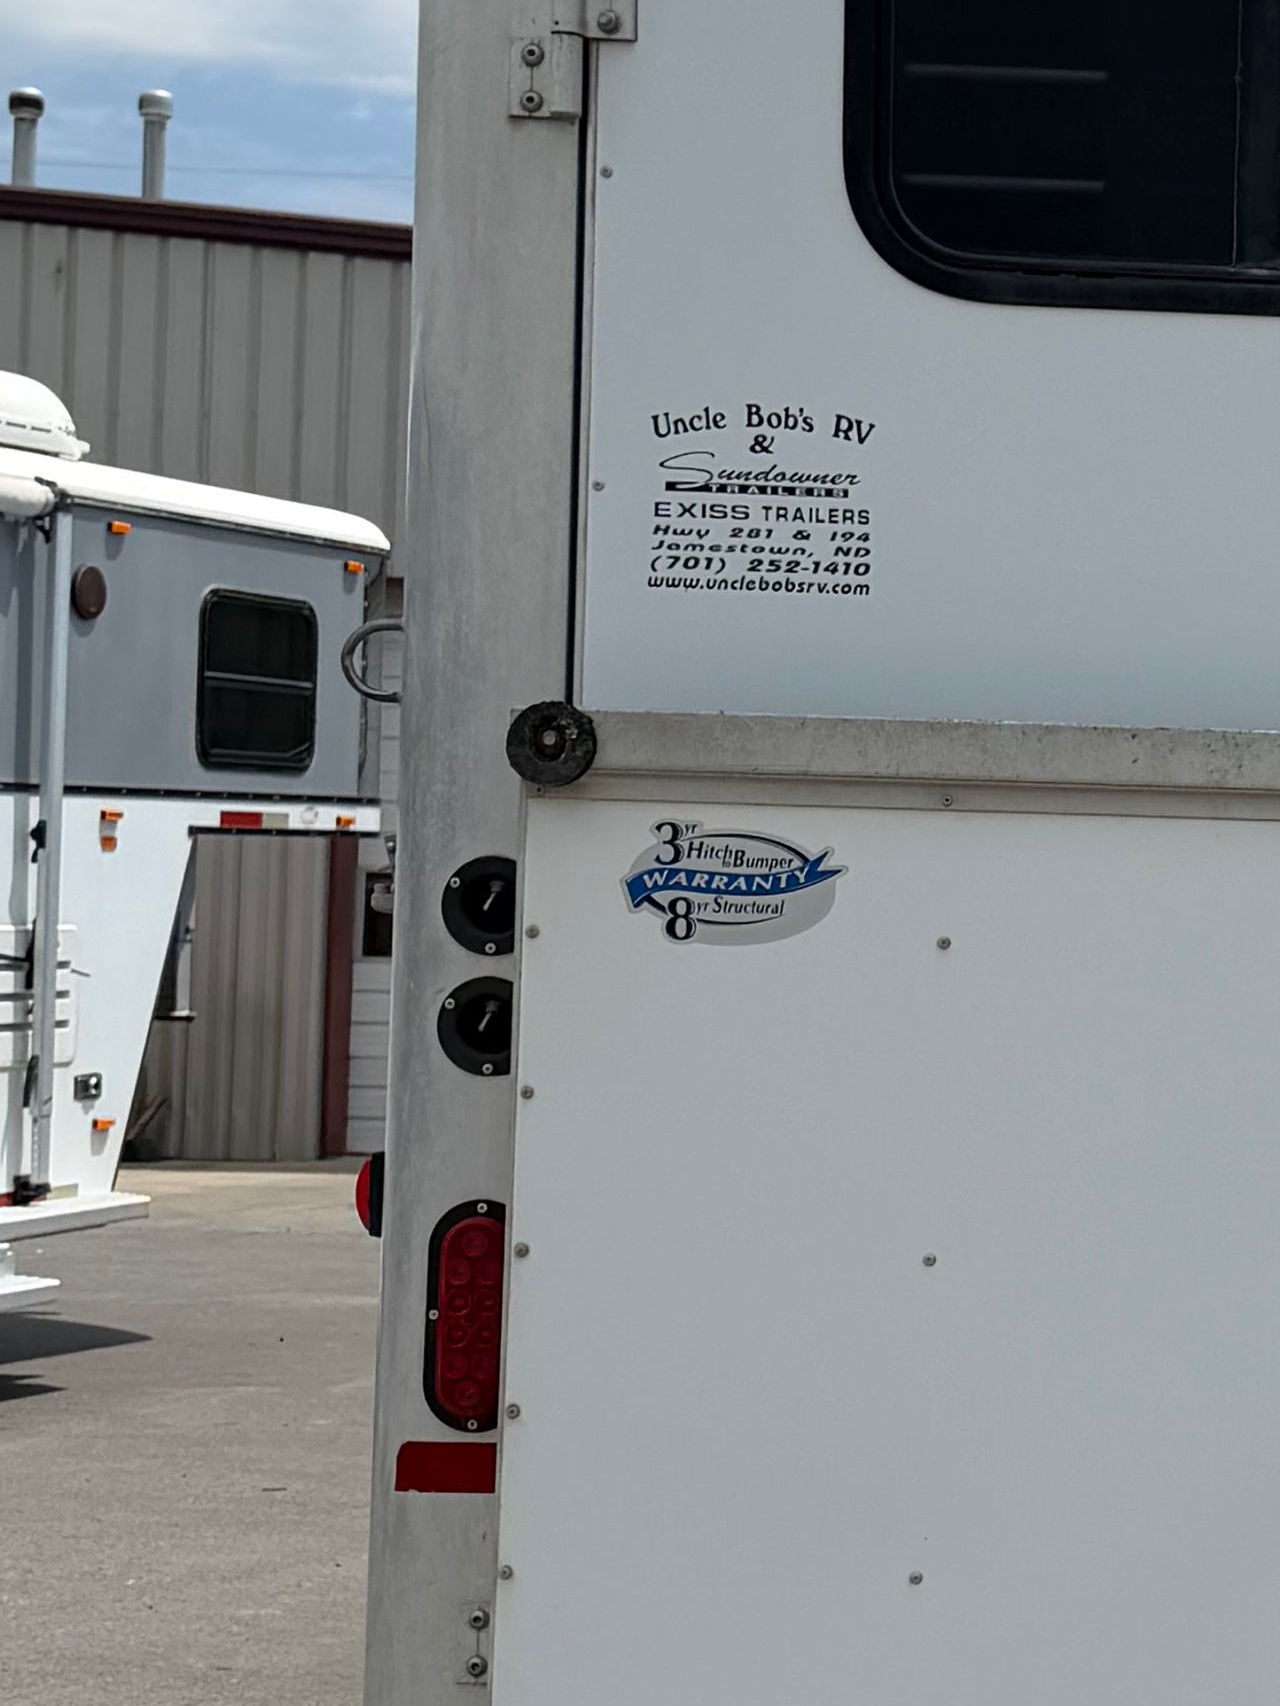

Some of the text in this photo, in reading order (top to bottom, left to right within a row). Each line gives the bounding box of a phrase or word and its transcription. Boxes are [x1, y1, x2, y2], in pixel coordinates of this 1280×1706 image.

[652, 403, 875, 445] Uncle Bob's RV
[749, 434, 774, 455] &
[659, 452, 861, 489] Sundowner
[709, 484, 845, 498] TRAILERS
[654, 502, 870, 525] EXISS TRAILERS
[652, 525, 710, 539] Hwy
[730, 528, 774, 539] 281
[792, 530, 811, 540] &
[652, 540, 870, 559] Jamestown, ND
[651, 556, 871, 576] (701) 252-1410
[648, 575, 870, 596] www.unclebobsrv.com
[687, 841, 733, 861] Hitch
[733, 850, 794, 872] Bumper
[643, 864, 808, 892] WARRANTY
[712, 896, 786, 916] Structural
